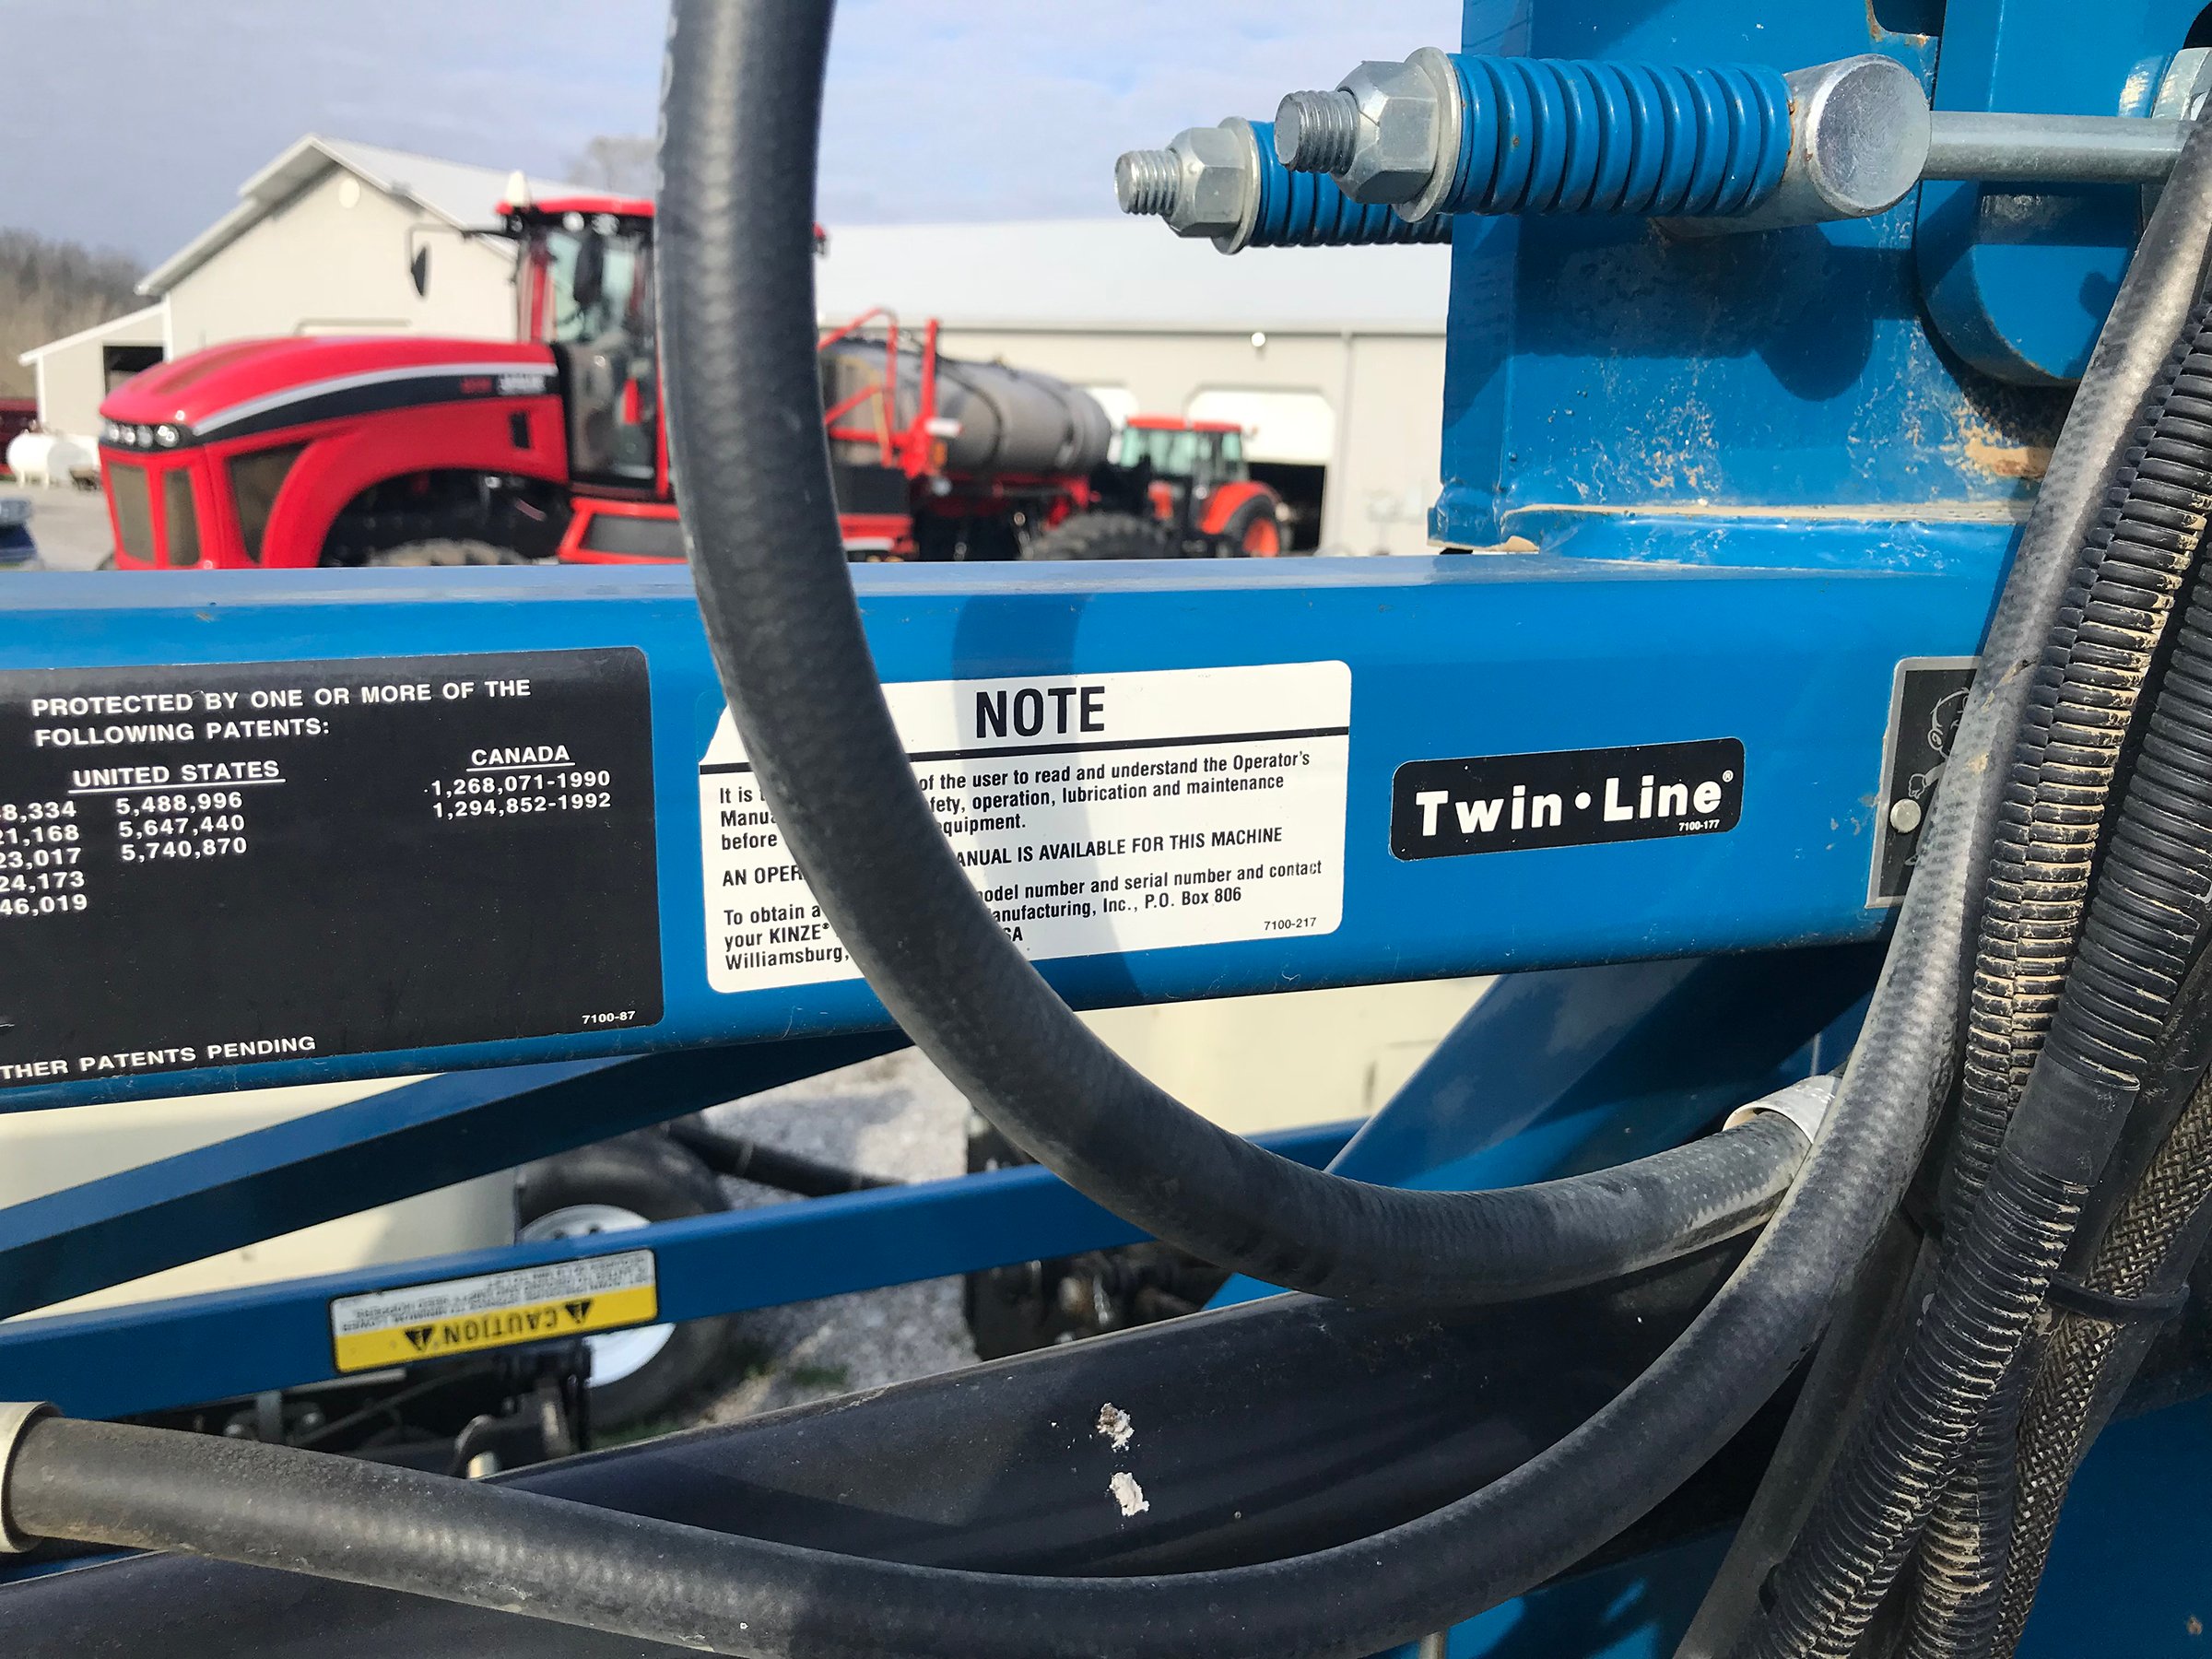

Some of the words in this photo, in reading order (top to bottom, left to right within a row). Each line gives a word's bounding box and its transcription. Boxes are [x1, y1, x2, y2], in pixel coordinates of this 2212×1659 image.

[30, 692, 194, 717] PROTECTED
[205, 691, 239, 711] BY
[251, 689, 303, 709] ONE
[314, 687, 350, 705] OR
[361, 683, 432, 703] MORE
[442, 682, 475, 700] OF
[485, 679, 531, 698] THE
[975, 686, 1105, 739] NOTE
[34, 723, 194, 747] FOLLOWING
[206, 718, 329, 739] PATENTS:
[471, 745, 571, 766] CANADA
[72, 765, 170, 787] UNITED
[182, 760, 280, 782] STATES
[431, 770, 611, 798] 1,268,071-1990
[919, 774, 935, 791] of
[940, 773, 967, 790] the
[972, 771, 1008, 788] user
[1013, 770, 1029, 785] to
[1035, 766, 1071, 783] read
[1077, 764, 1105, 781] and
[1112, 758, 1197, 779] understand
[1204, 757, 1228, 772] the
[1233, 750, 1310, 772] Operator's
[0, 800, 76, 823] 8,334
[115, 791, 243, 818] 5,488,996
[432, 792, 612, 820] 1,294,852-1992
[720, 787, 732, 804] It
[738, 785, 753, 803] is
[972, 789, 1056, 813] operation,
[1063, 782, 1147, 804] lubrication
[1153, 780, 1181, 797] and
[1187, 776, 1284, 794] maintenance
[1416, 784, 1562, 837] Twin
[118, 814, 245, 840] 5,647,440
[1678, 819, 1720, 831] 7100-177
[121, 837, 248, 863] 5,740,870
[722, 832, 777, 850] before
[1018, 845, 1033, 863] IS
[1039, 839, 1125, 861] AVAILABLE
[1132, 836, 1164, 853] FOR
[1170, 833, 1206, 850] THIS
[1211, 827, 1282, 847] MACHINE
[723, 869, 747, 887] AN
[755, 865, 805, 885] OPER
[1025, 880, 1085, 899] number
[1090, 876, 1119, 893] and
[1124, 872, 1168, 889] serial
[1174, 868, 1232, 886] number
[1237, 864, 1264, 881] and
[1269, 860, 1322, 878] contact
[724, 909, 743, 925] To
[750, 903, 805, 924] obtain
[811, 905, 821, 918] a
[989, 900, 1097, 923] anufacturing,
[1103, 898, 1137, 914] Inc.,
[1145, 892, 1175, 909] P.O.
[1182, 890, 1209, 906] Box
[1214, 887, 1241, 903] 806
[1264, 917, 1317, 931] 7100-217
[724, 933, 763, 953] your
[725, 947, 850, 971] Williamsburg,
[582, 1010, 636, 1025] 7100-87
[0, 1059, 69, 1079] THER
[78, 1045, 197, 1072] PATENTS
[207, 1035, 317, 1061] PENDING
[443, 1309, 559, 1339] CAUTION
